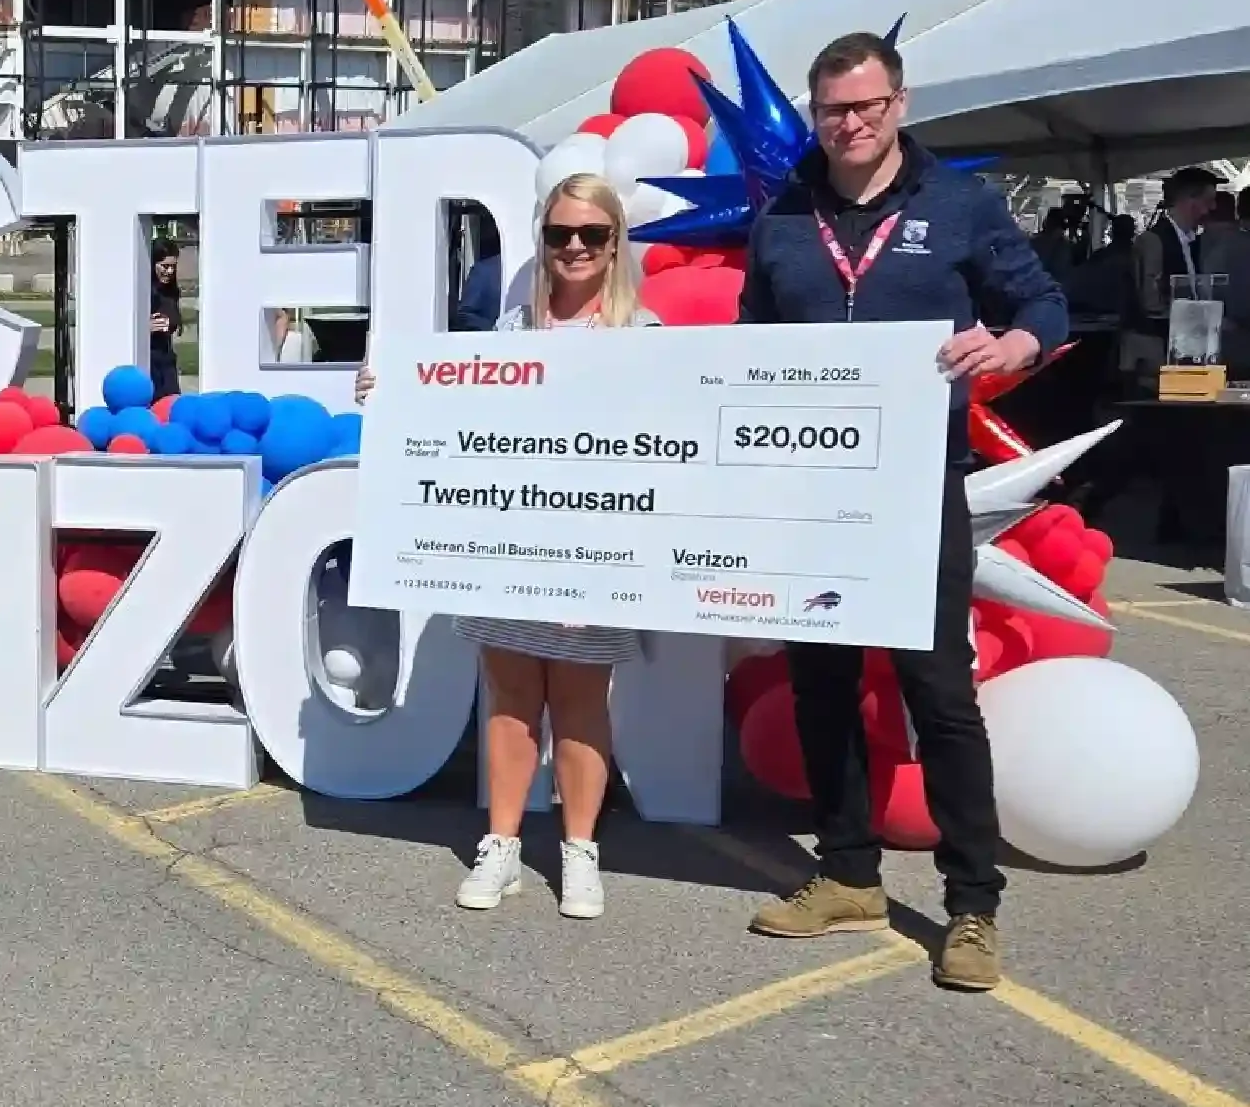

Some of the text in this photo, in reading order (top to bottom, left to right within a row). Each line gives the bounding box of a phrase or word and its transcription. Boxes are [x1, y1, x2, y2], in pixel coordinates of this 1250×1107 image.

[417, 354, 545, 386] verizon
[700, 375, 724, 385] Date
[748, 367, 776, 383] May
[820, 368, 860, 381] 2025
[457, 430, 699, 463] Veterans One Stop
[734, 424, 860, 453] $20,000
[418, 479, 655, 512] Twenty thousand
[414, 538, 634, 562] Veteran Small Business Support
[671, 548, 748, 568] Verizon
[696, 587, 776, 607] verizon
